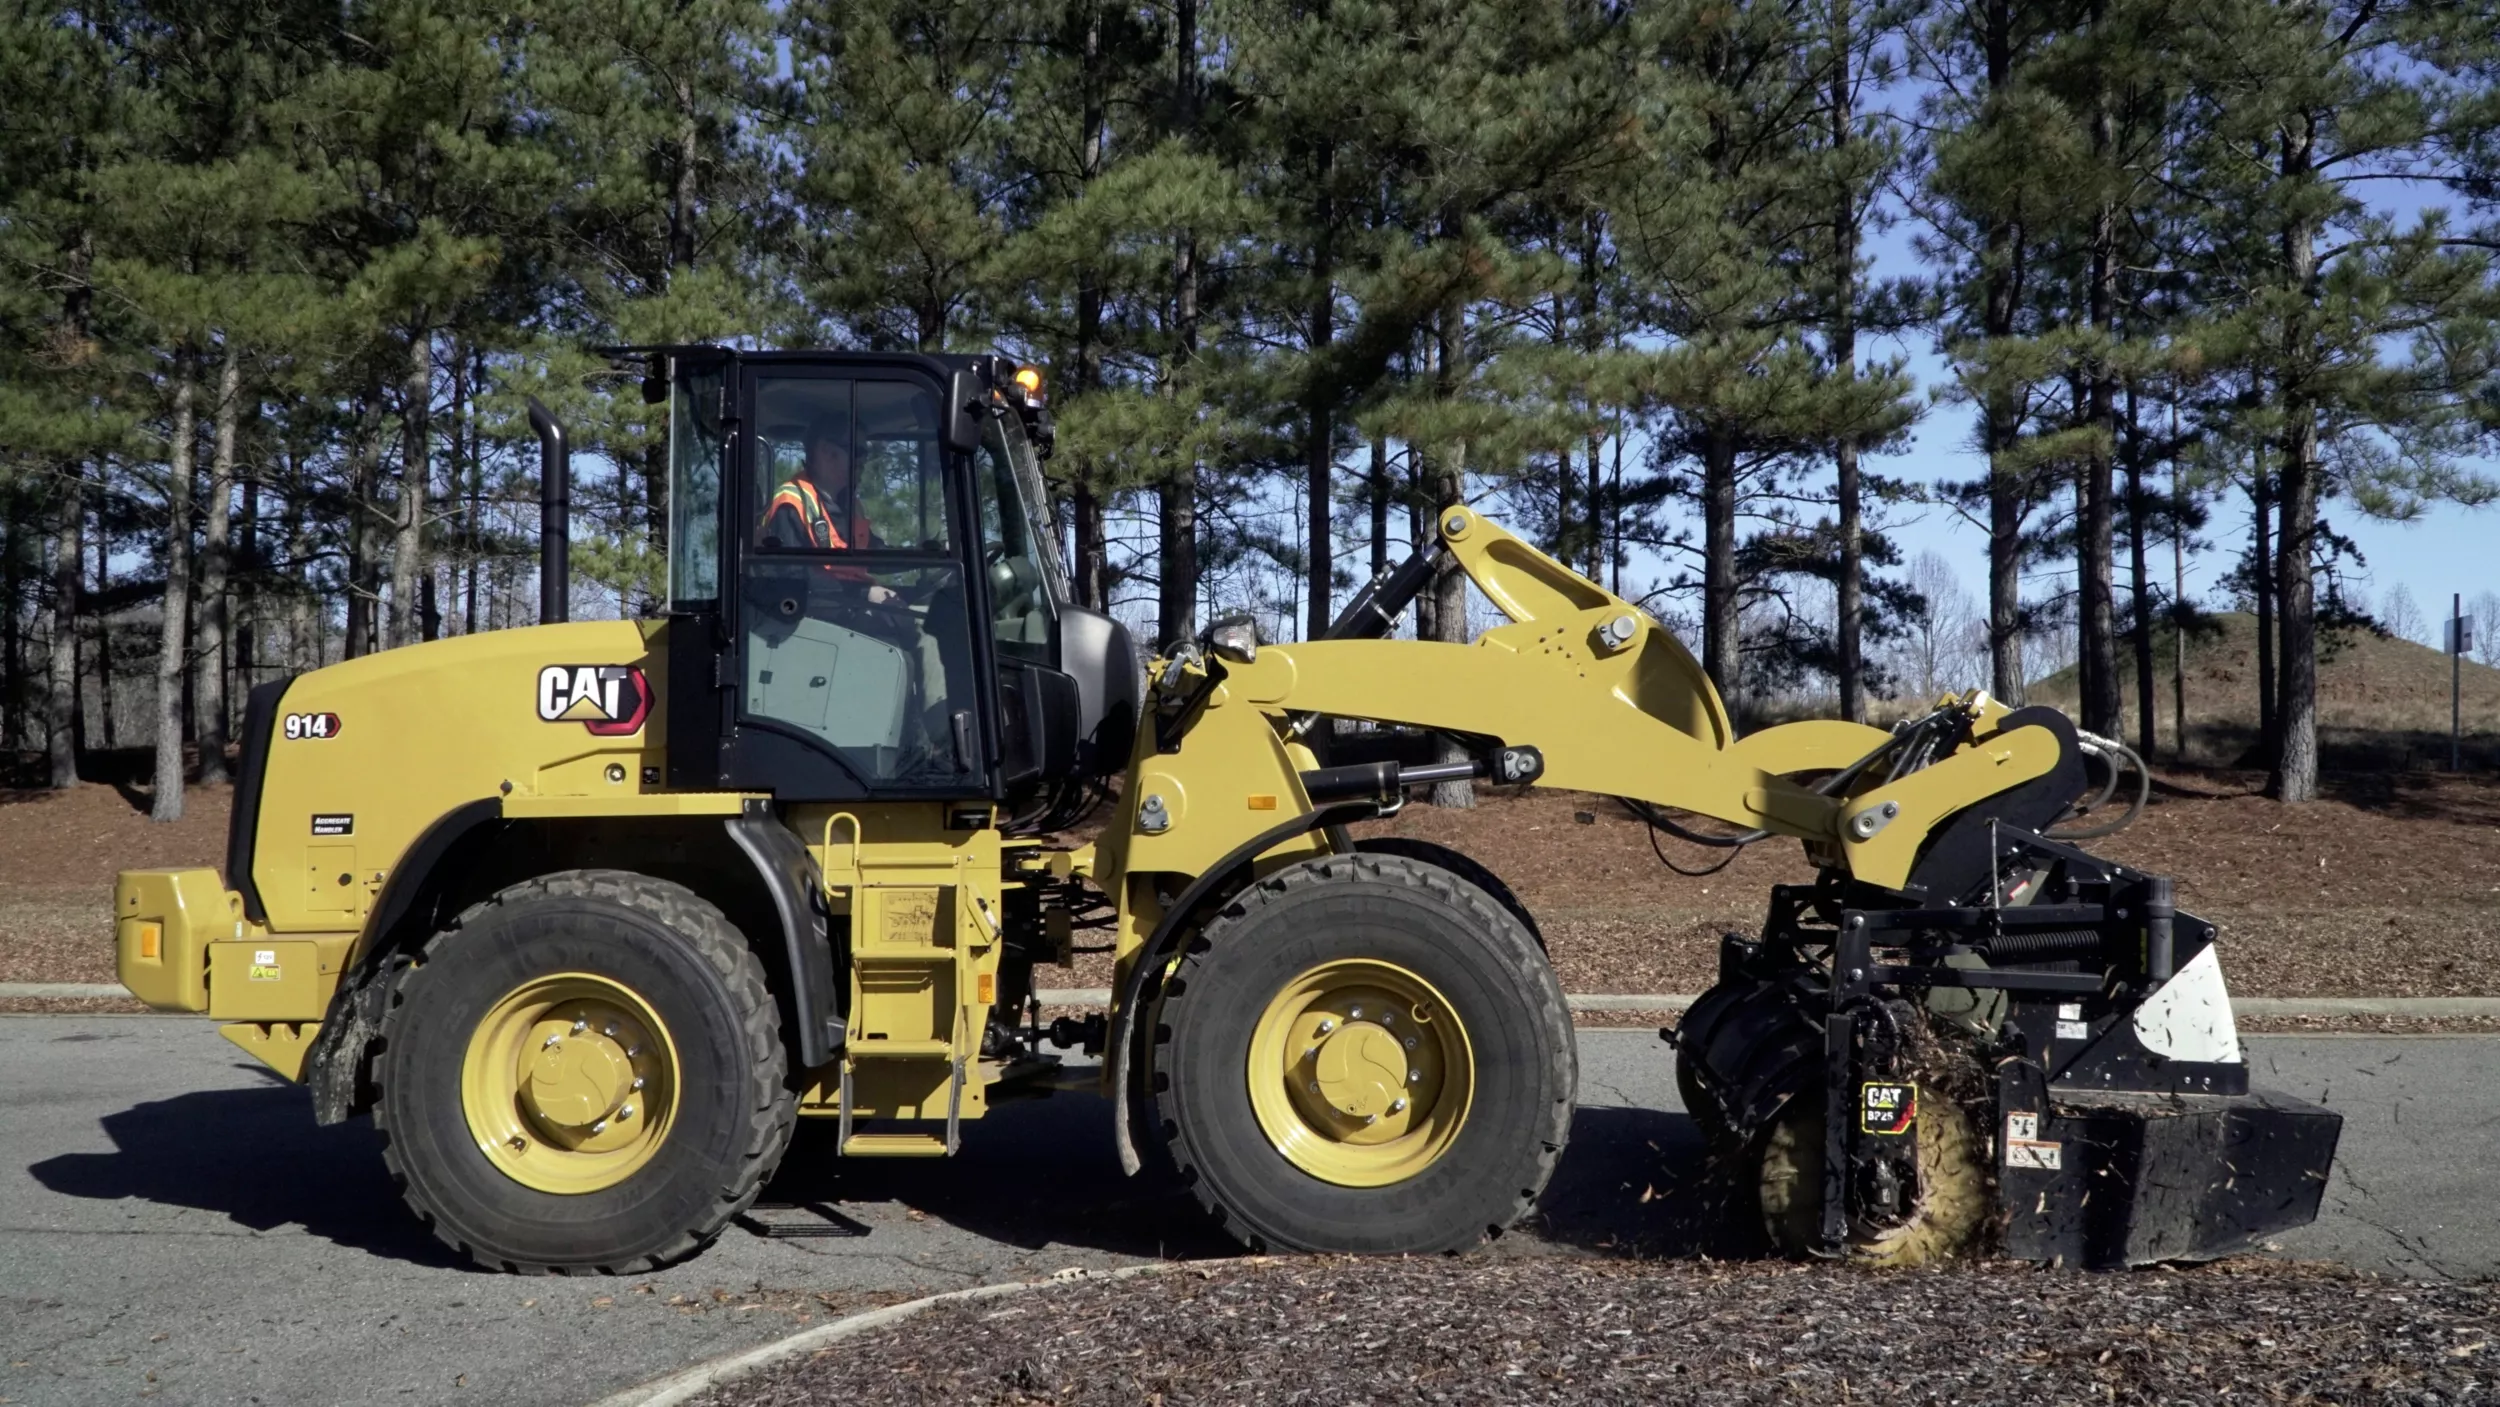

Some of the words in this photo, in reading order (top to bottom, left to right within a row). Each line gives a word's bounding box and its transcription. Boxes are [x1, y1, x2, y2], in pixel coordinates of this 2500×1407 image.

[540, 666, 627, 720] CAT
[286, 714, 327, 739] 914
[1867, 1087, 1902, 1108] CAT
